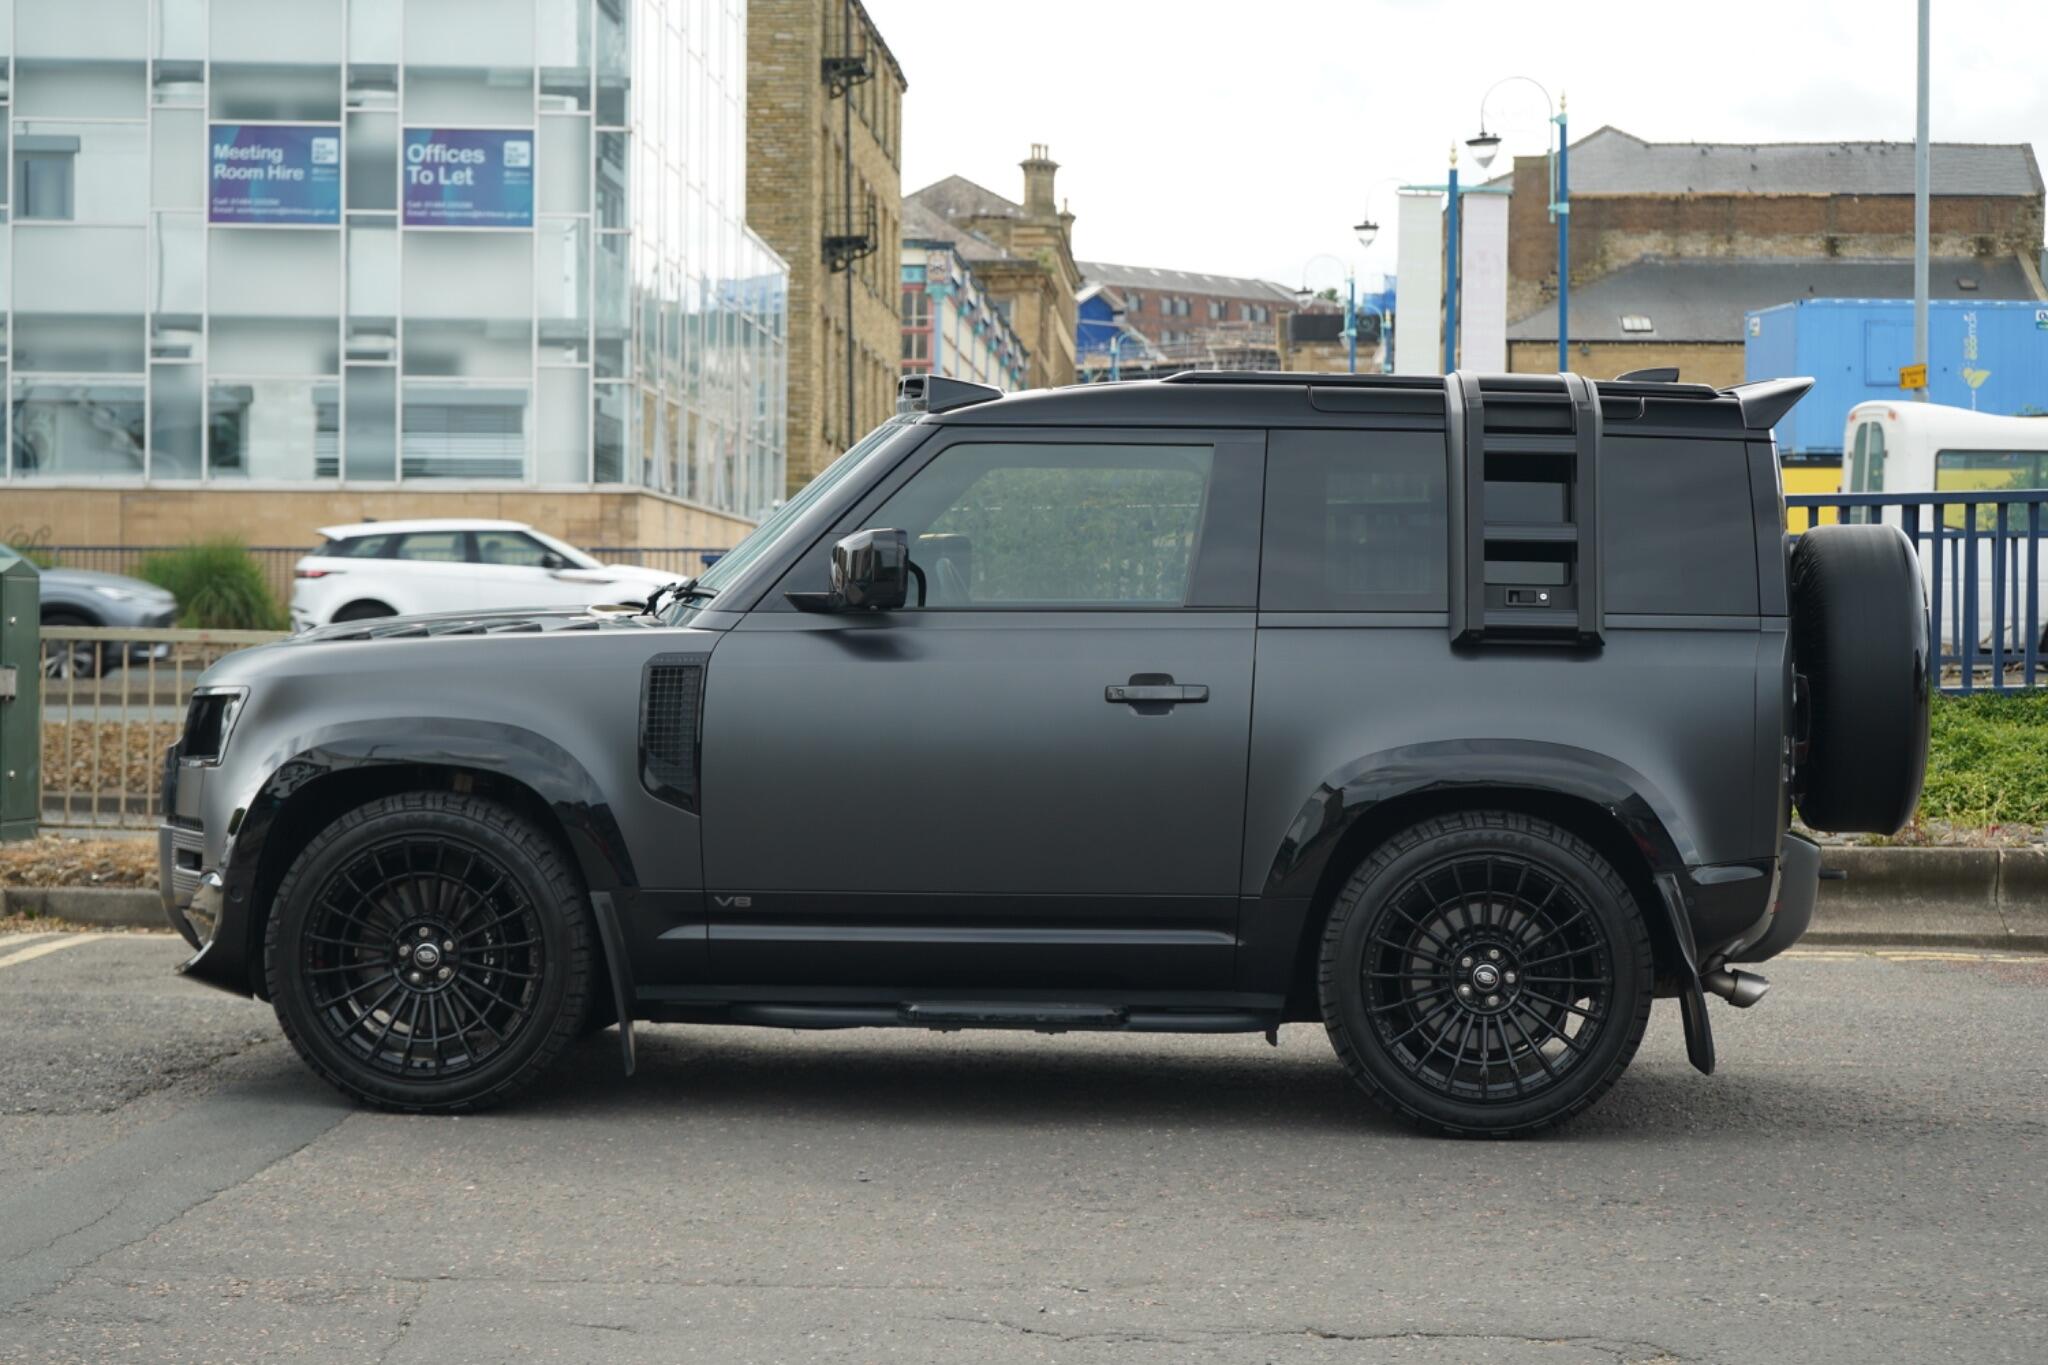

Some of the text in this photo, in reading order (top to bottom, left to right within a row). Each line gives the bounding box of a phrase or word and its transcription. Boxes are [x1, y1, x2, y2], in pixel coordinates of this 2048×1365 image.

[213, 144, 283, 163] Meeting
[407, 144, 486, 165] Offices
[213, 164, 264, 181] Room
[267, 164, 304, 182] Hire
[408, 166, 474, 186] To Let
[714, 896, 752, 907] V8
